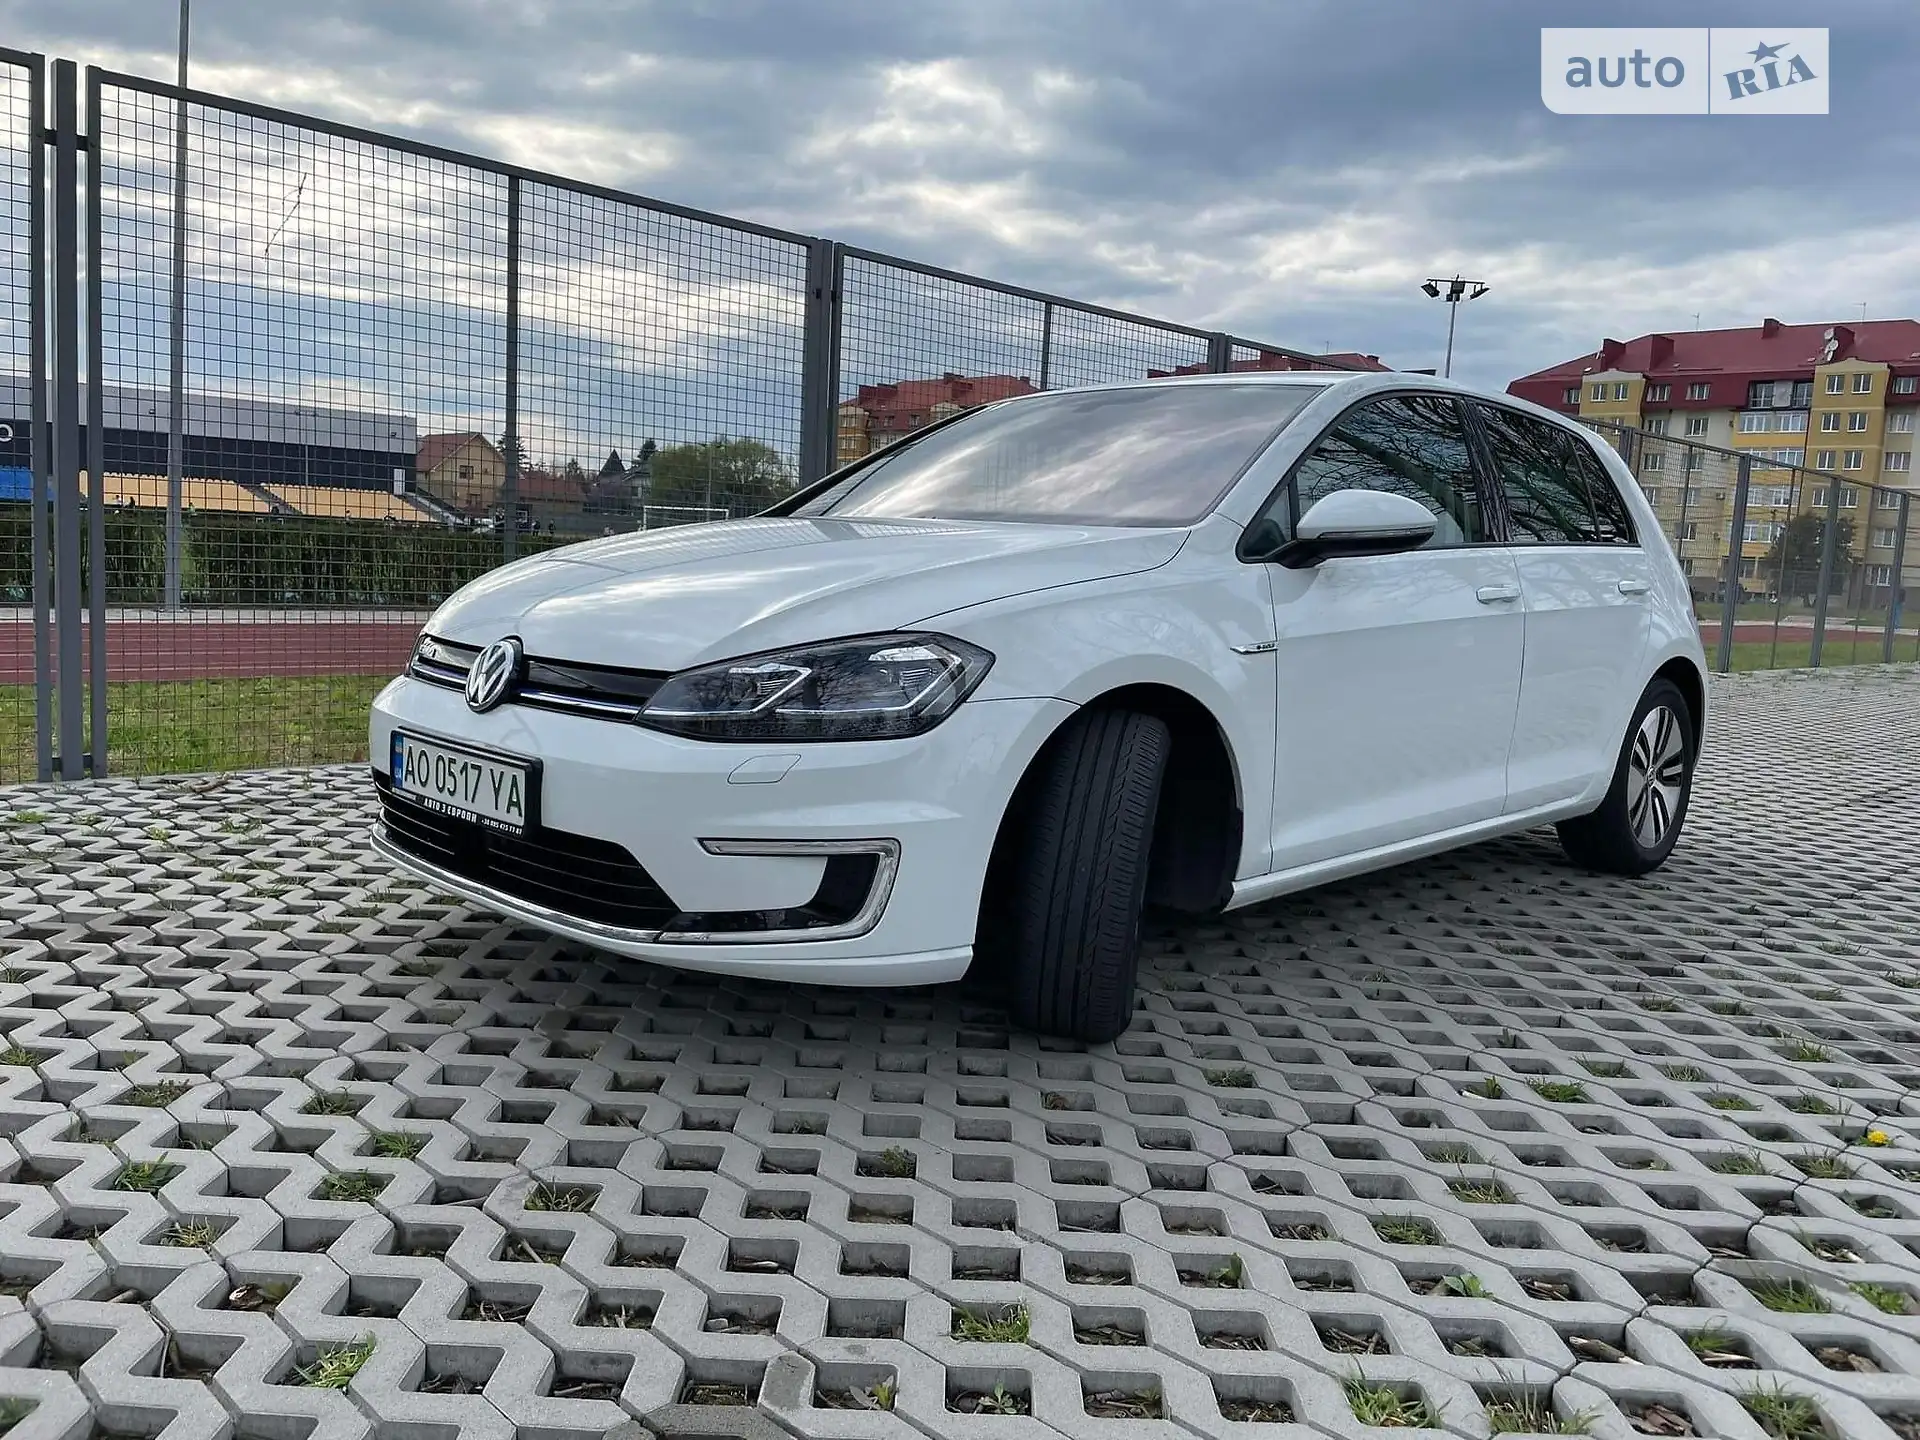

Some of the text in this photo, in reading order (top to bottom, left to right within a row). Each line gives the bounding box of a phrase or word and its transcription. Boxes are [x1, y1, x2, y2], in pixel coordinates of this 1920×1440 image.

[404, 745, 523, 818] AO 0517 YA
